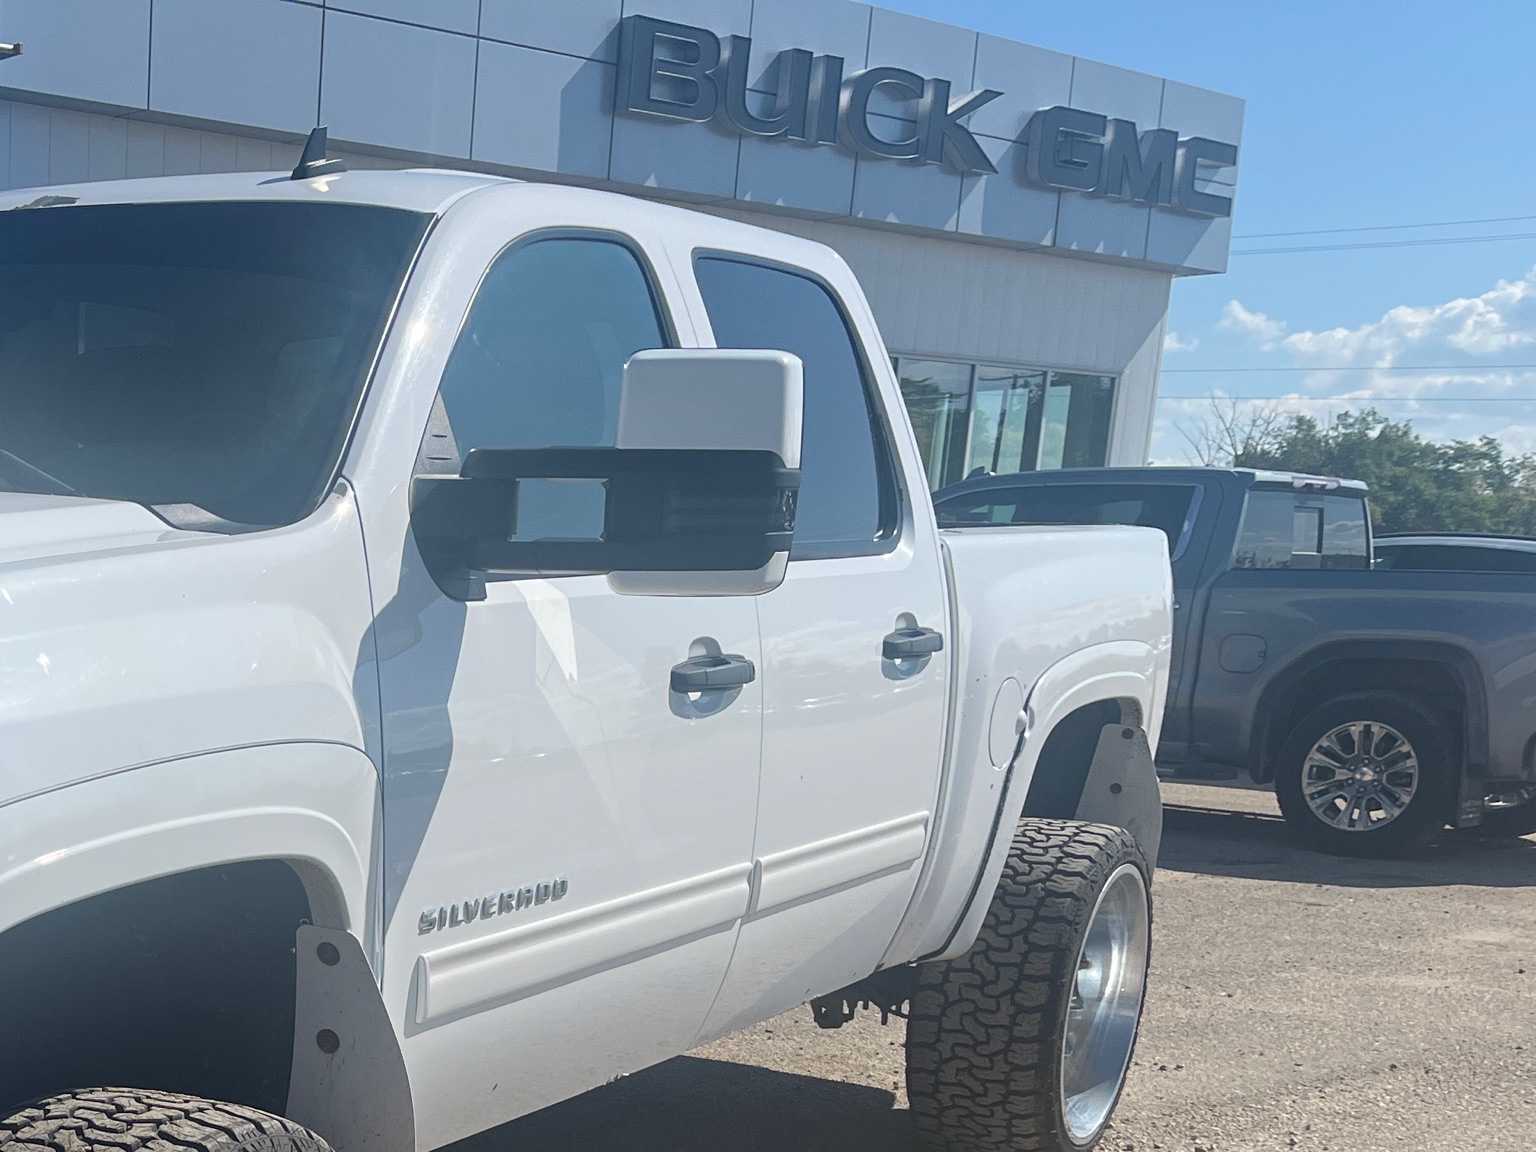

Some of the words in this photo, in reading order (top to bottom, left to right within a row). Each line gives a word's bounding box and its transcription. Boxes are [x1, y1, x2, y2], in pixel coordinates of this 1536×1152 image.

[621, 14, 1005, 174] BUICK
[1026, 106, 1238, 217] GMC
[417, 874, 569, 936] SILVERADO
